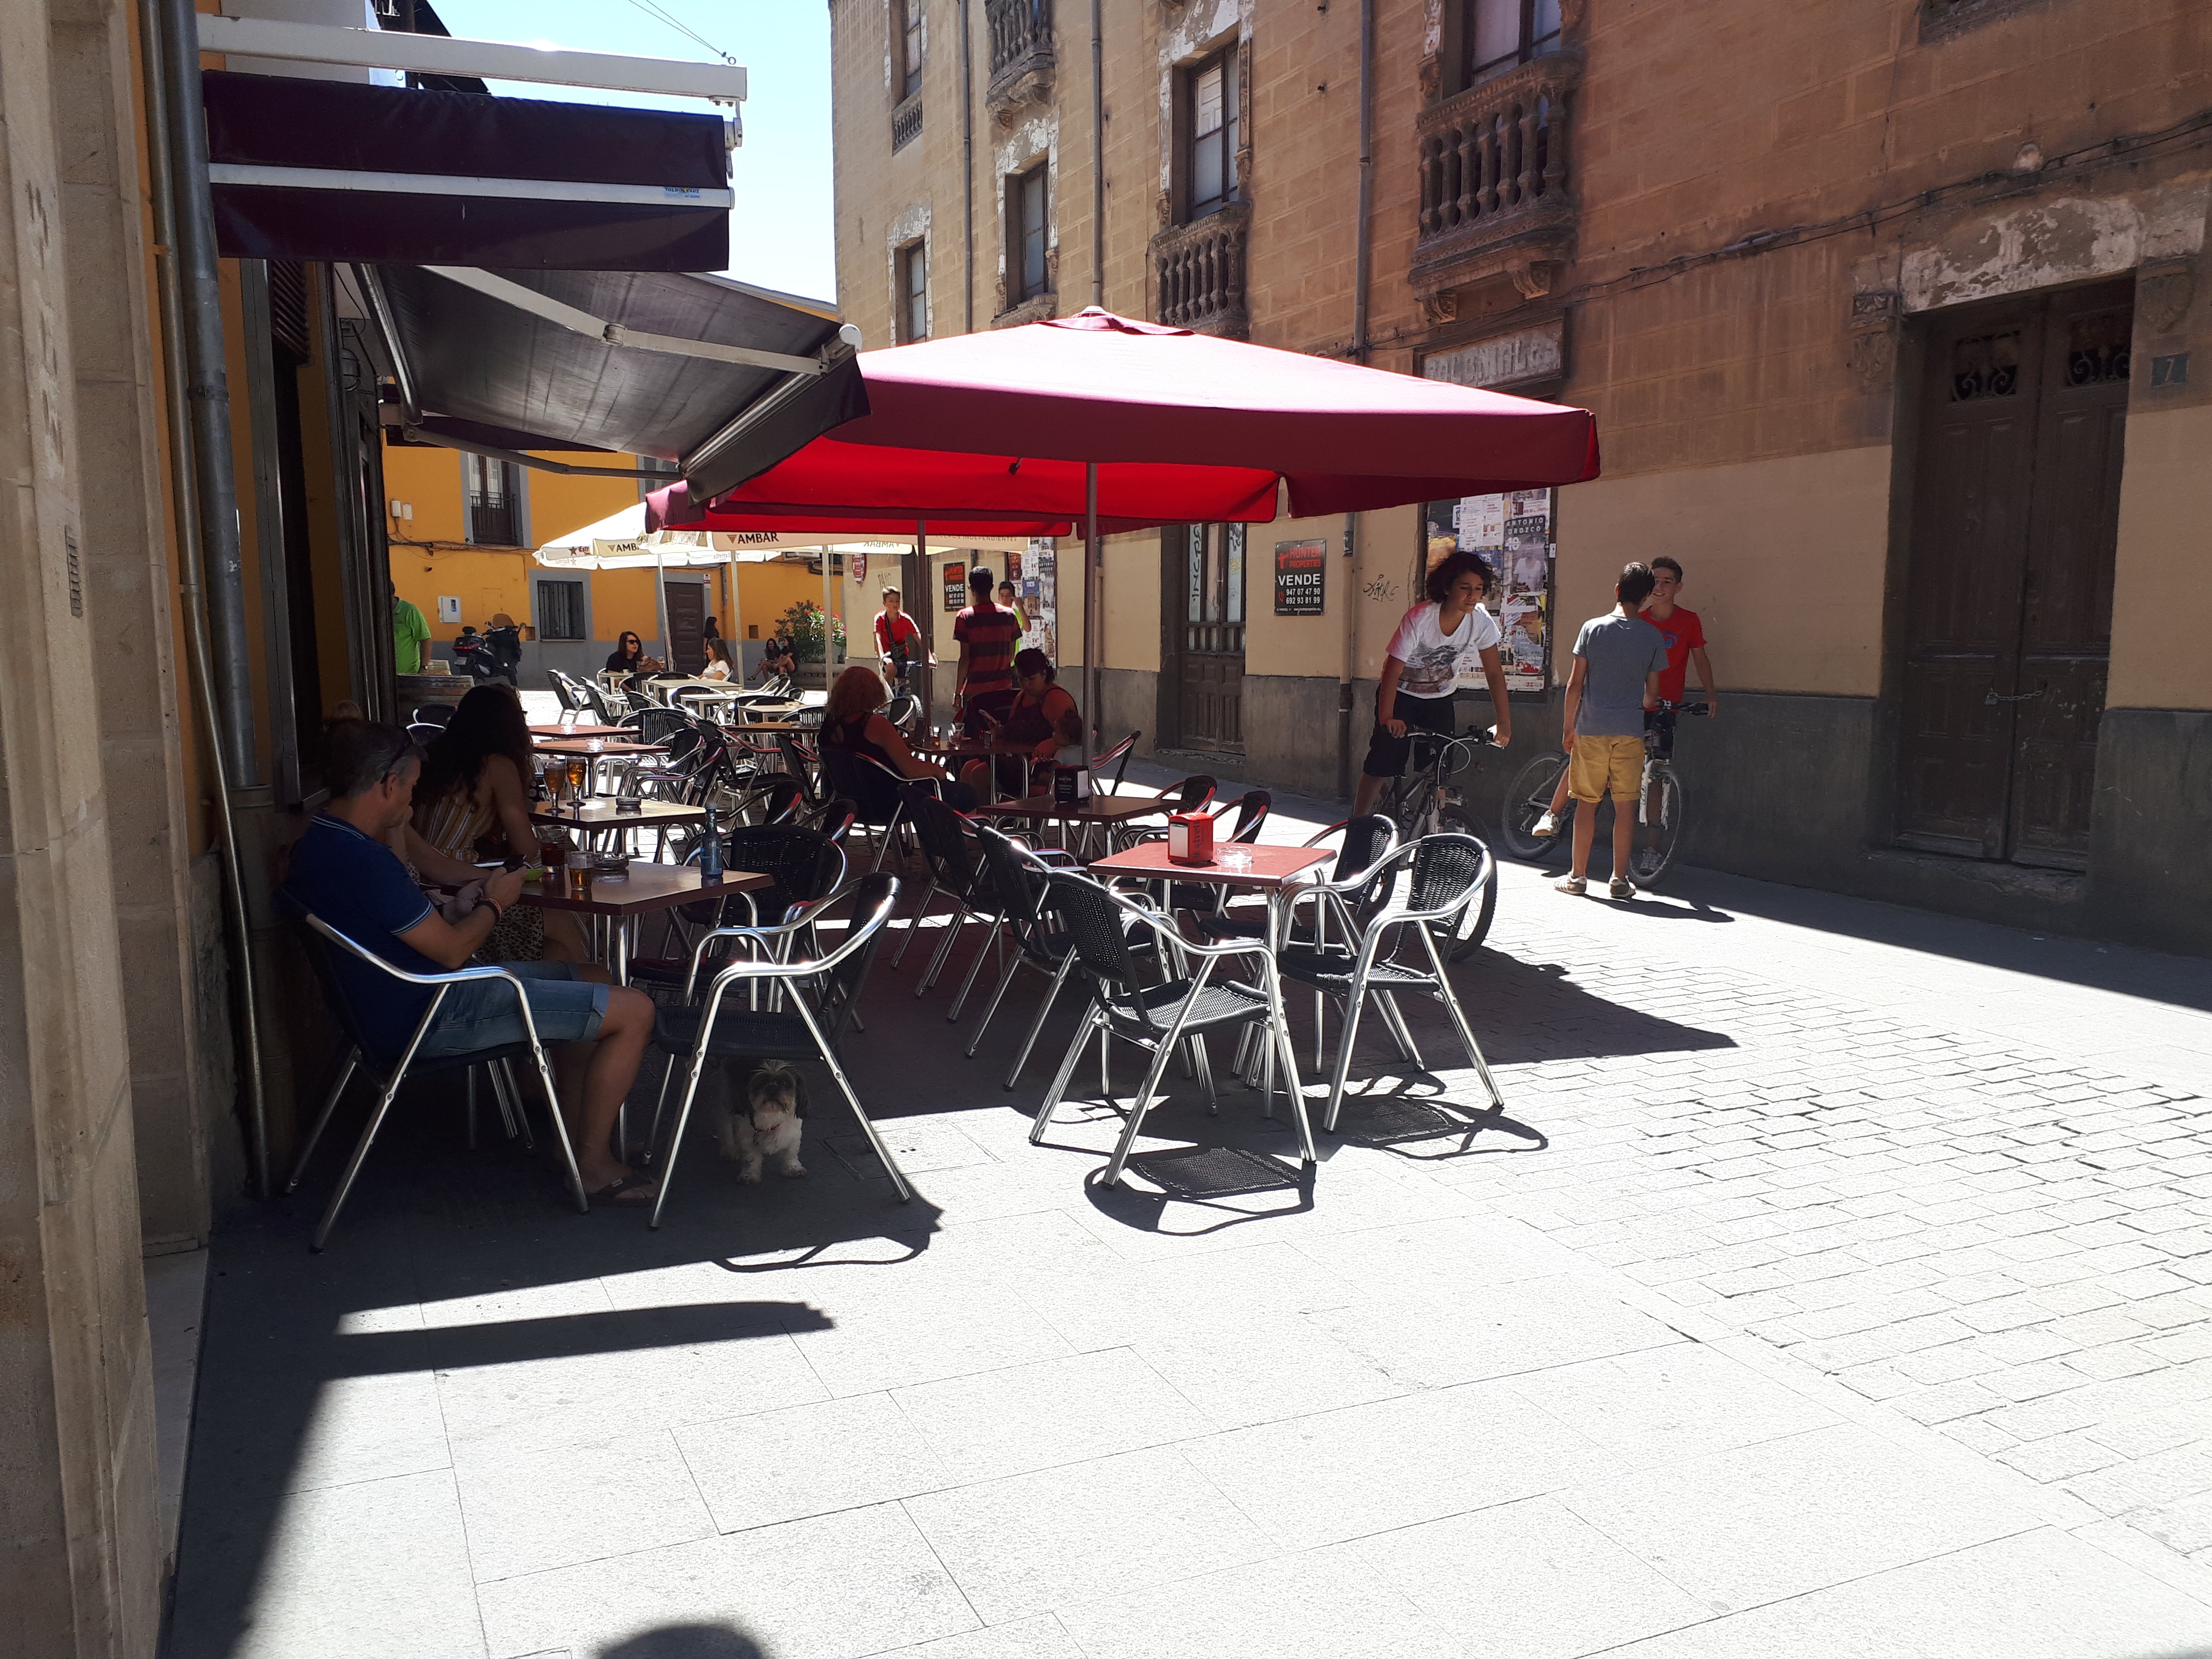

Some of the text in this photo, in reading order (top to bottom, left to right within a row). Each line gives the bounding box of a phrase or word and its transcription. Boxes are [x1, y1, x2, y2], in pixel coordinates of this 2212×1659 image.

[1506, 517, 1543, 527] ANTONIO
[1508, 526, 1541, 535] OROZCO
[737, 532, 780, 544] AMBAR
[616, 542, 639, 552] AMB
[1290, 545, 1321, 559] HUNTER
[1289, 559, 1321, 568] PROPERTIES
[1278, 574, 1321, 586] VENDE
[945, 584, 964, 593] VENDE
